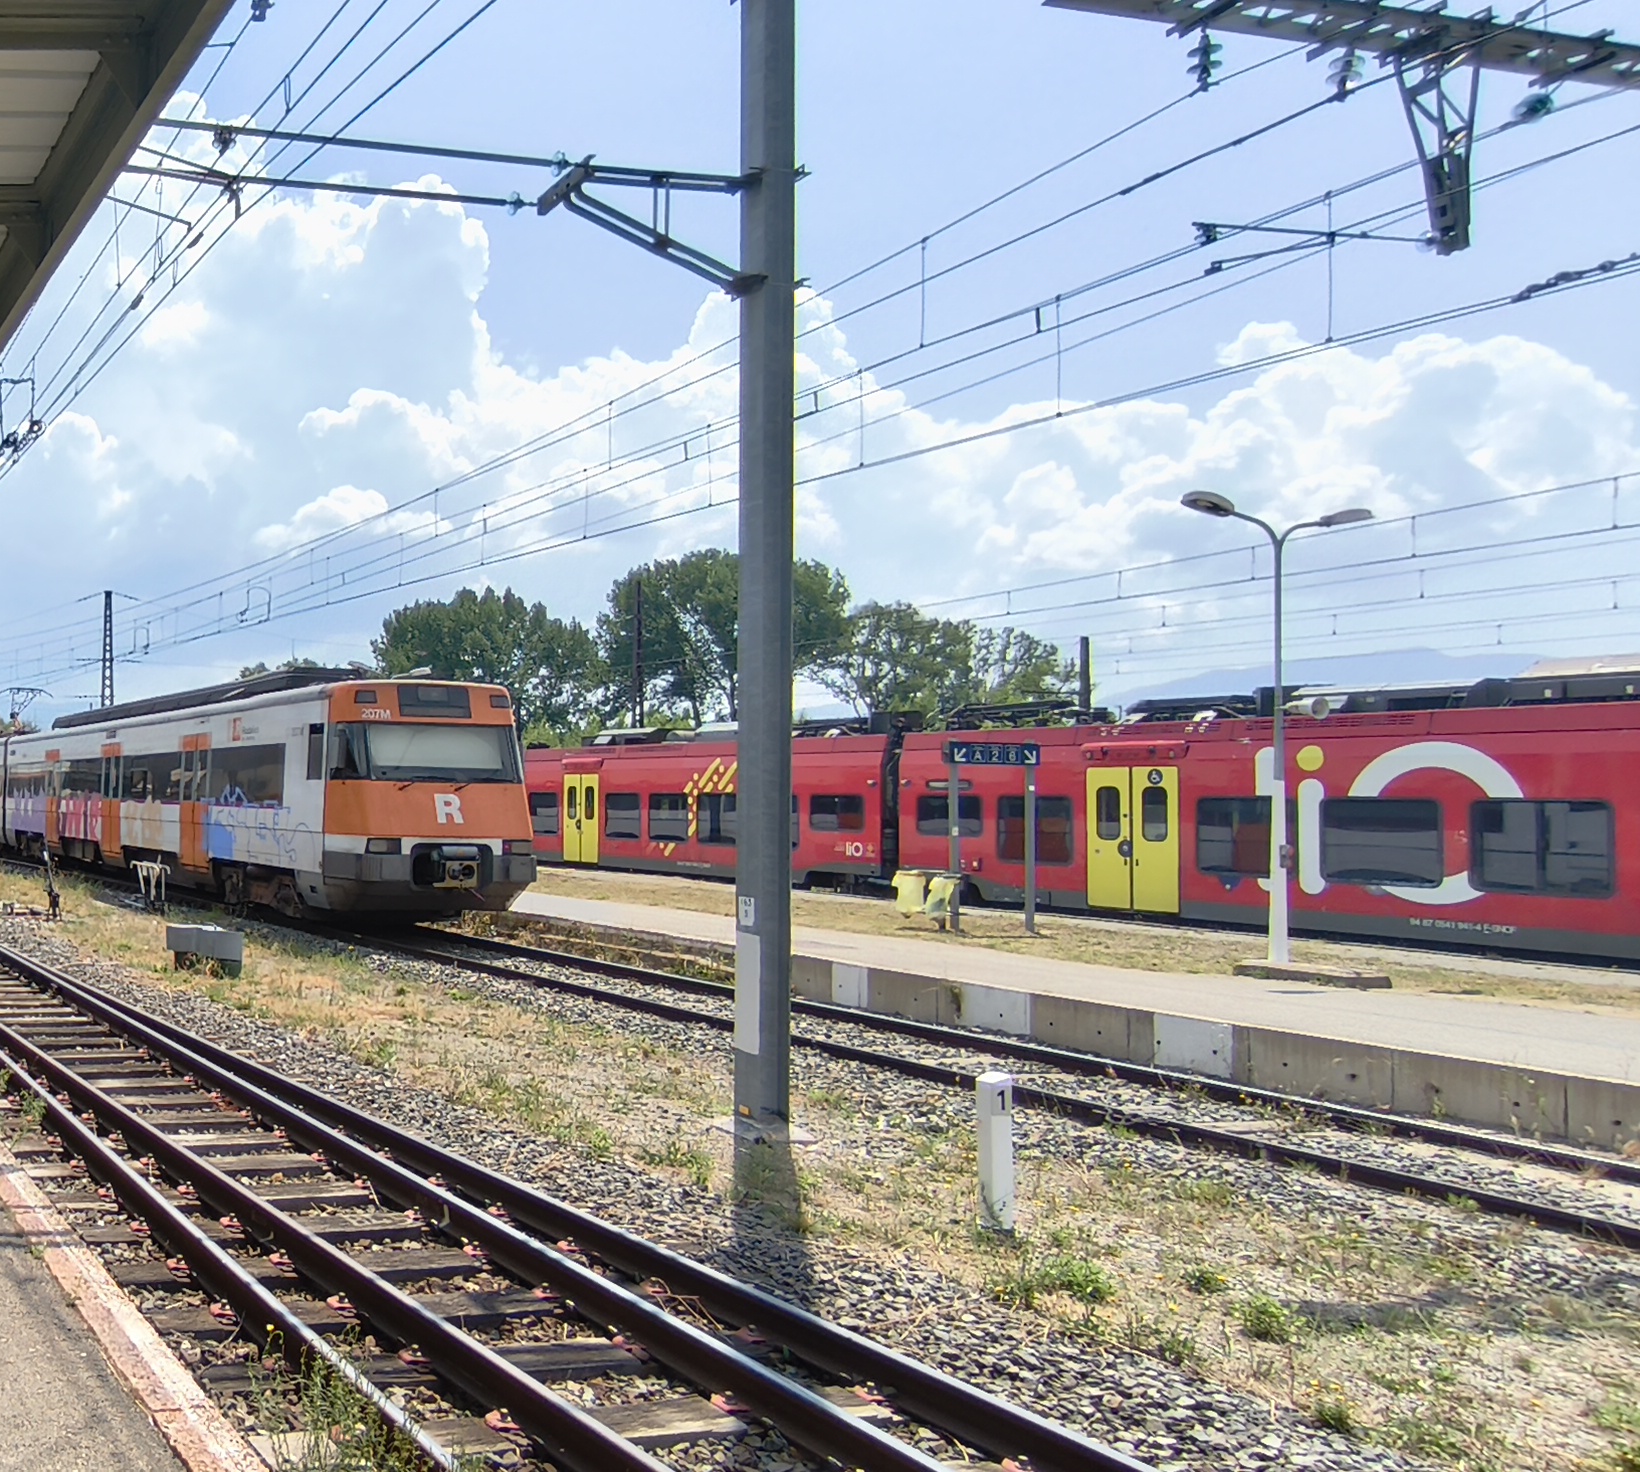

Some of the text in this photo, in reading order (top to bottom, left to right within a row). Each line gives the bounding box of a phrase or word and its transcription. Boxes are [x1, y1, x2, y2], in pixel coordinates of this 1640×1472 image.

[361, 708, 391, 719] 207M
[973, 750, 982, 761] A
[991, 750, 999, 761] 2
[434, 793, 464, 824] R
[996, 1089, 1006, 1111] 1
